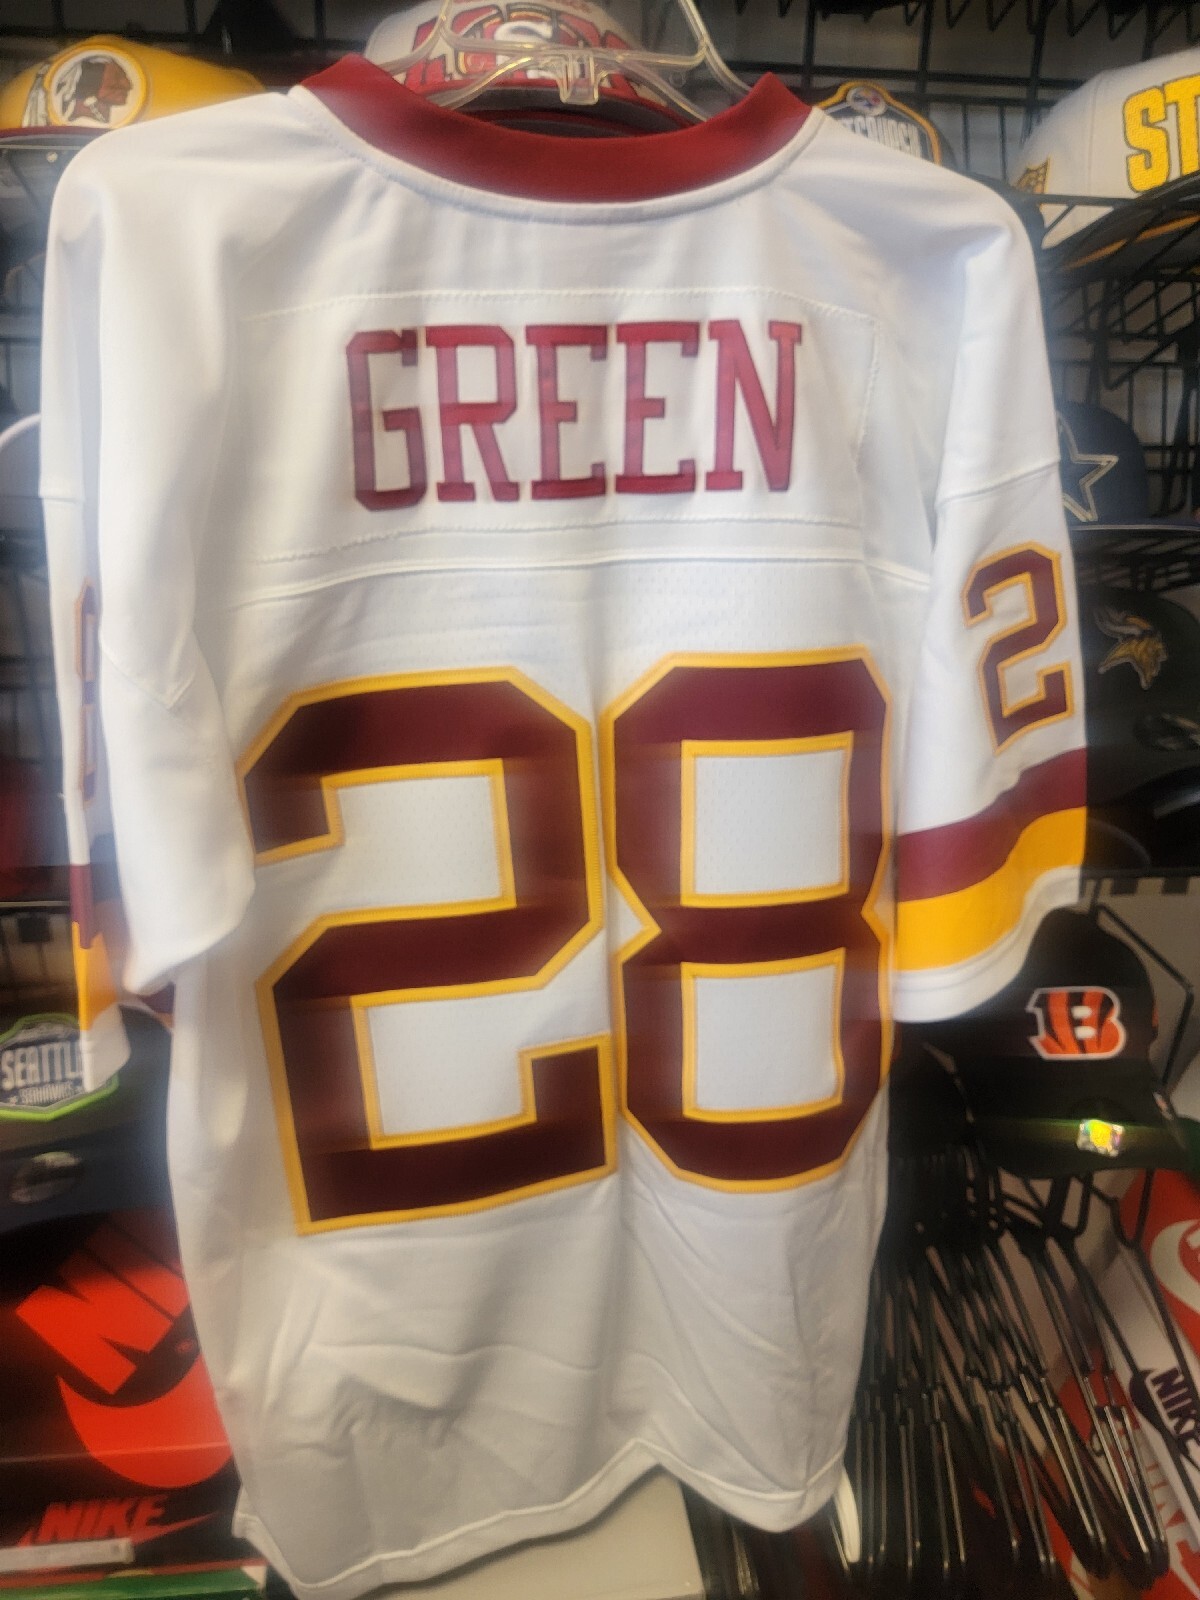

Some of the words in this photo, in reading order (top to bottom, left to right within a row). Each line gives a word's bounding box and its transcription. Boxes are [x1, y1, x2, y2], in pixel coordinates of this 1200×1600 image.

[345, 319, 802, 512] GREEN
[961, 540, 1074, 757] 2
[235, 645, 894, 1236] 28
[37, 1495, 168, 1542] NIKE
